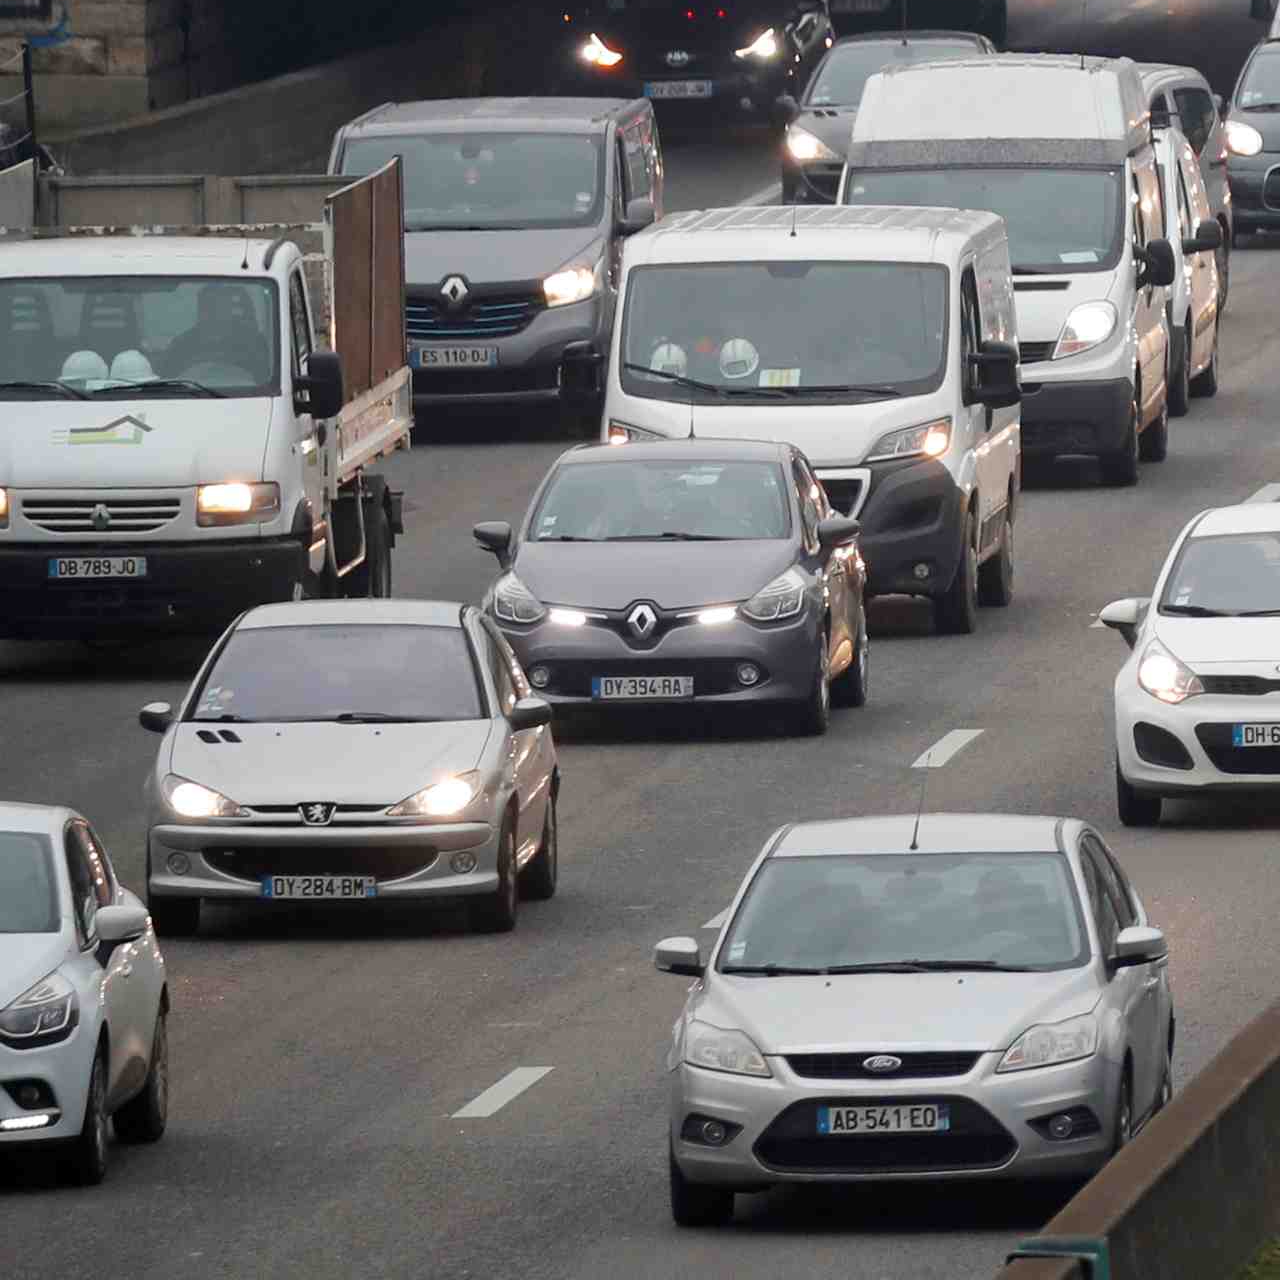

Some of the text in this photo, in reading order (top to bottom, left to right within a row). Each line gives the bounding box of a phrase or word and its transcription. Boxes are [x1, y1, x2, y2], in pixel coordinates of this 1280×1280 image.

[604, 679, 681, 695] DY-394-RA
[274, 878, 364, 896] DY-284-BM
[833, 1107, 936, 1131] AB-541-EQ
